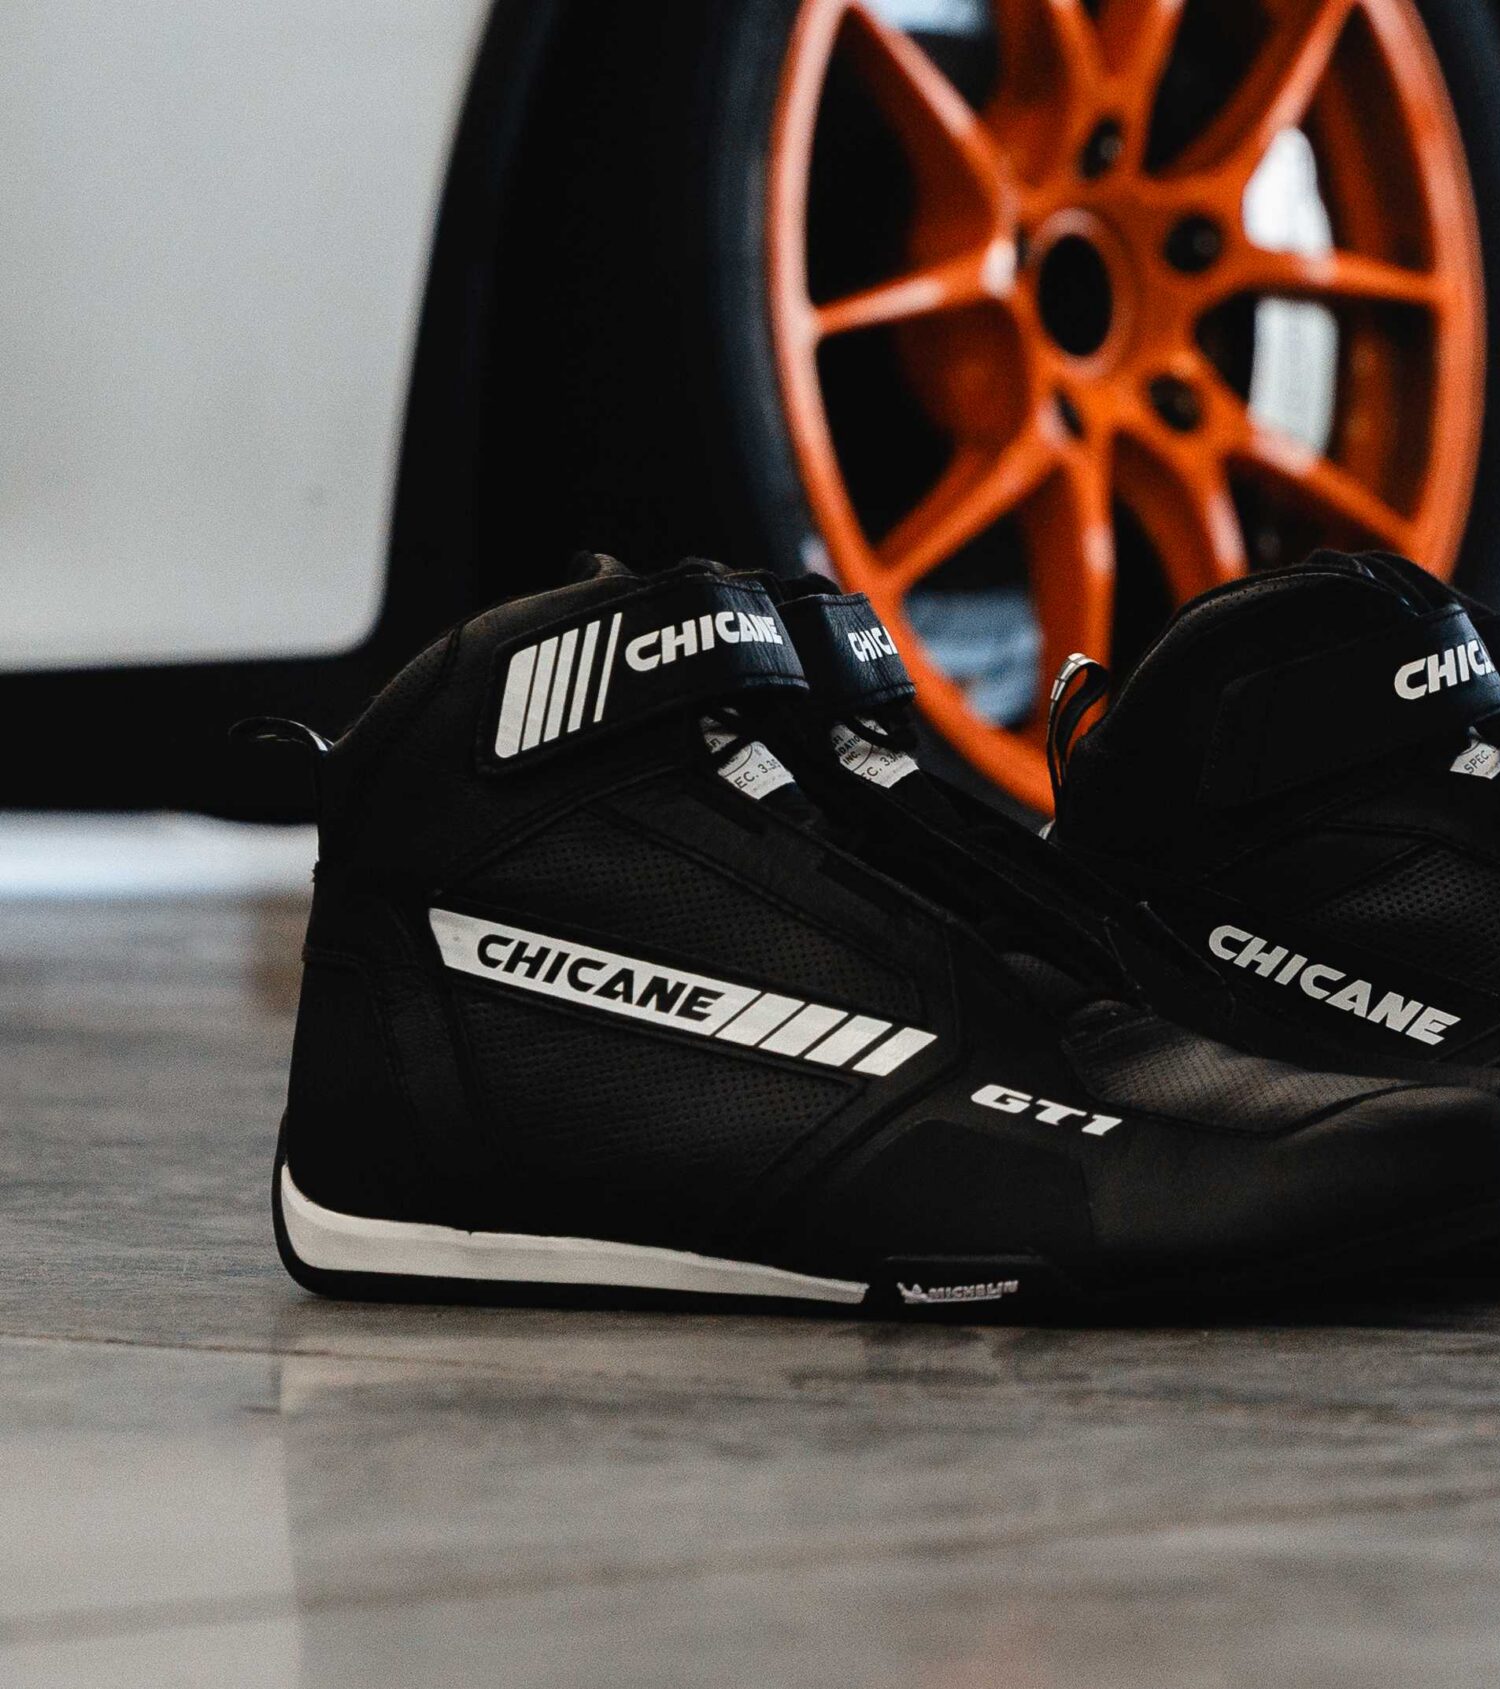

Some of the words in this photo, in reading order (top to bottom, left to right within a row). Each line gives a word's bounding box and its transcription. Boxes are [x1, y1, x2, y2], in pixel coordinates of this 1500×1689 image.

[626, 611, 784, 672] CHICANE
[734, 770, 760, 789] EC.
[476, 933, 726, 1022] CHICANE
[1209, 925, 1461, 1045] CHICANE
[971, 1085, 1122, 1136] GT1
[927, 1279, 1019, 1299] MICHELIN
